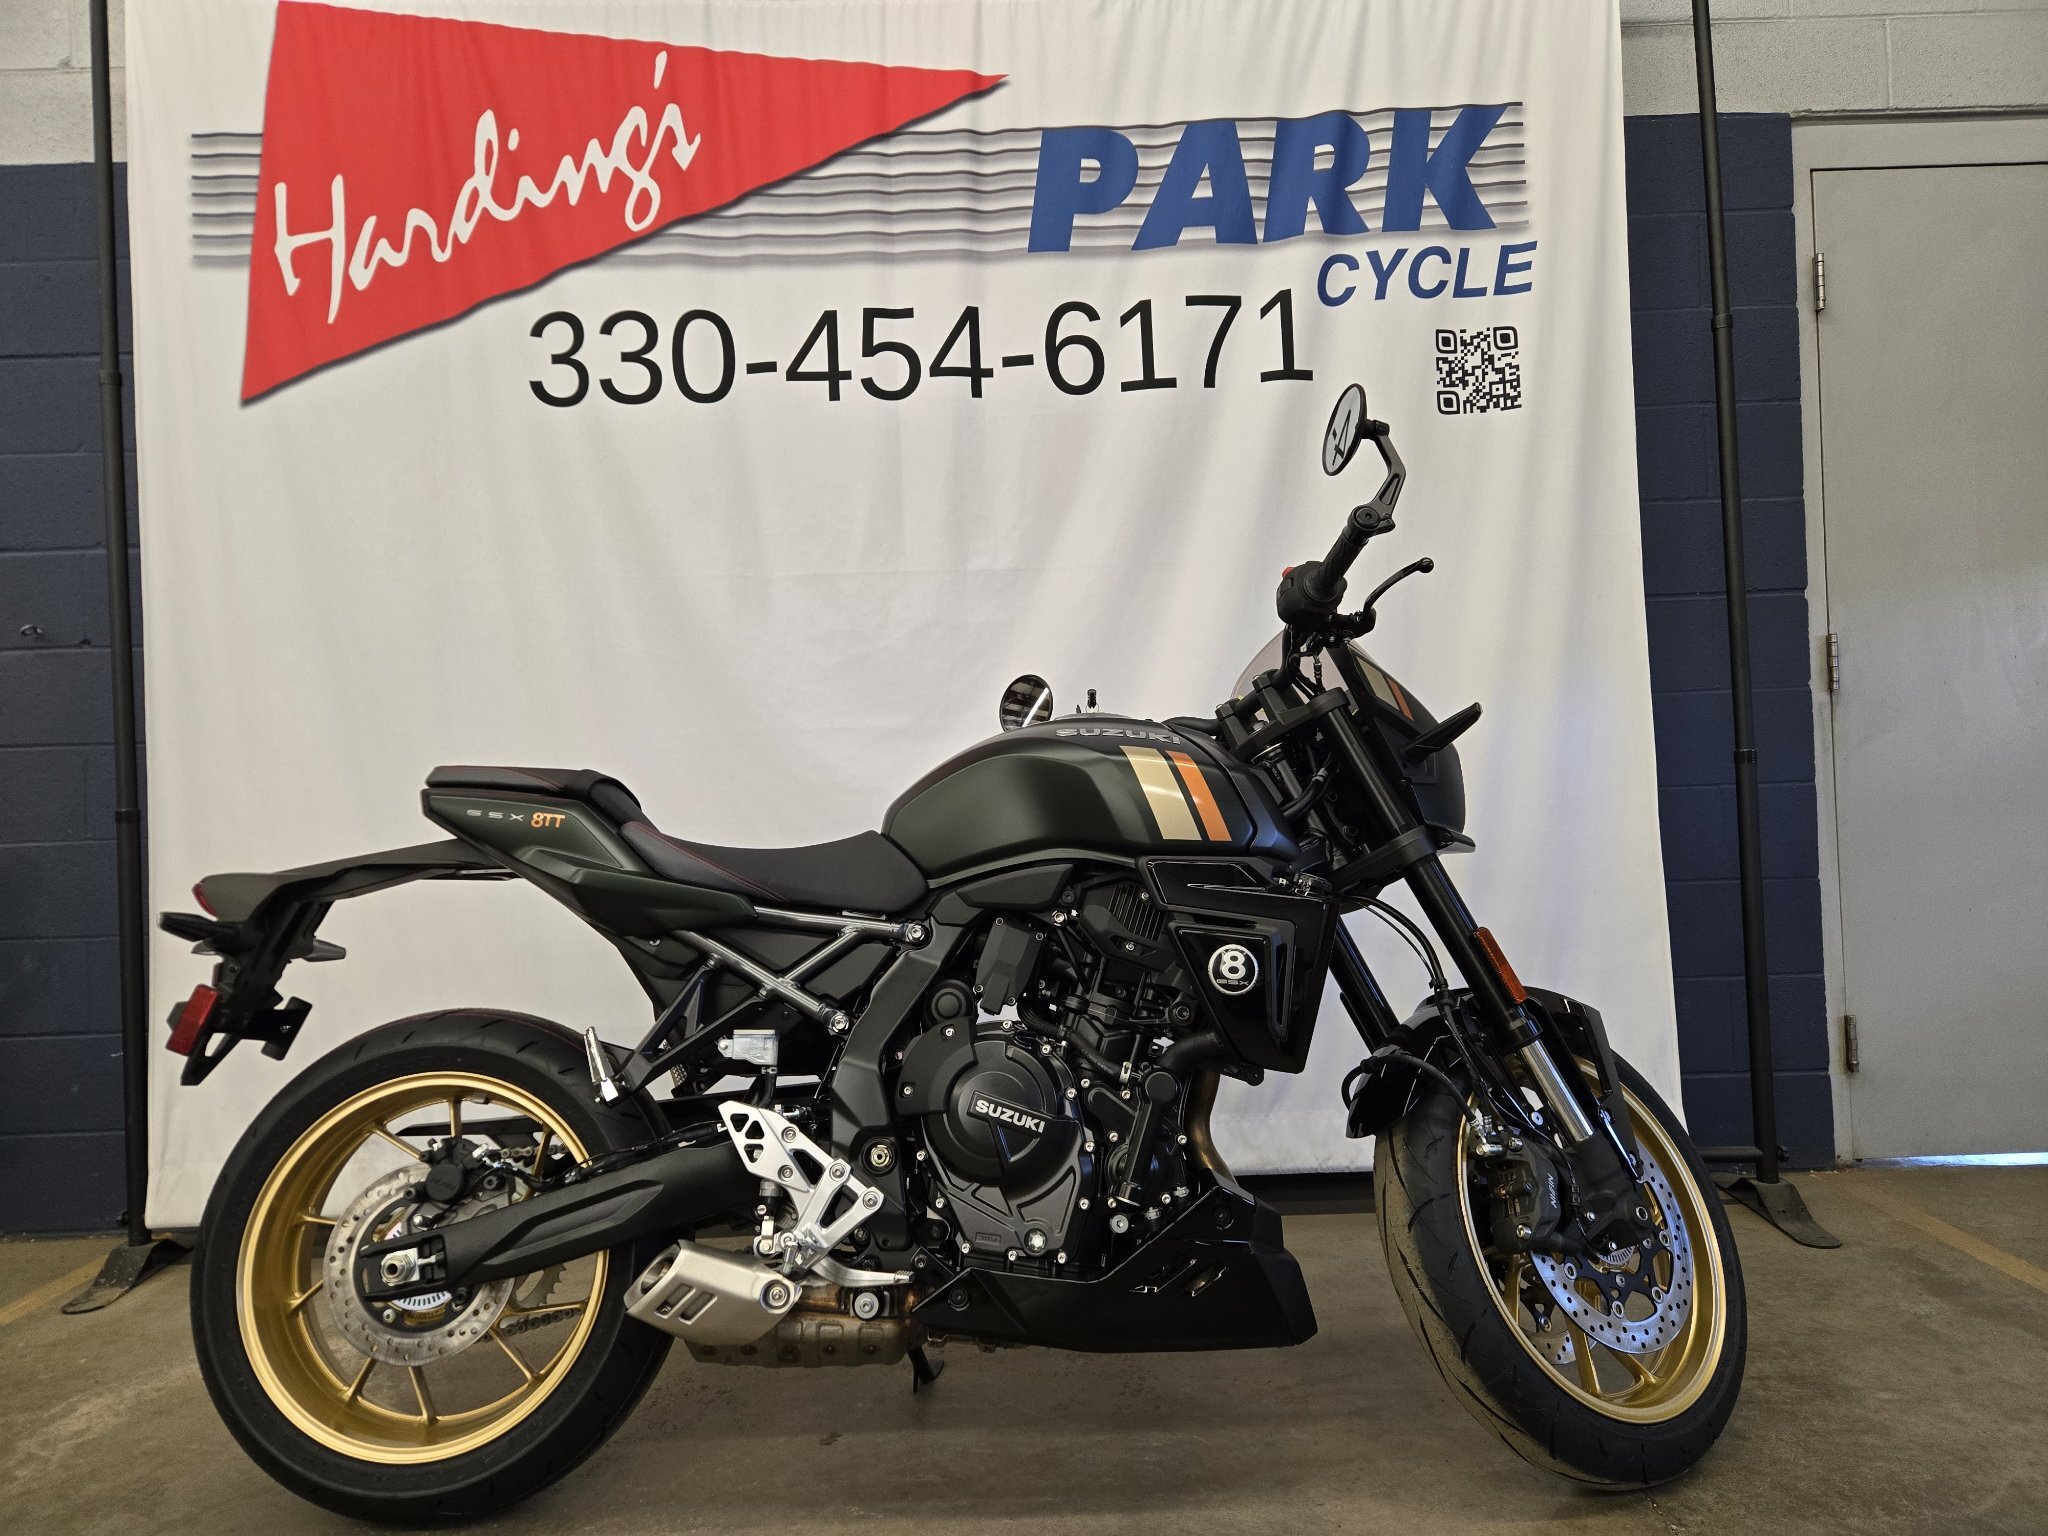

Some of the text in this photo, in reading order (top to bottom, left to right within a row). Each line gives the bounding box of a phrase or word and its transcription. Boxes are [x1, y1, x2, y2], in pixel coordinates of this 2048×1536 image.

[274, 51, 701, 324] Harding's
[1027, 104, 1508, 253] PARK
[1317, 240, 1538, 307] CYCLE
[528, 288, 1314, 408] 330-454-6171
[1055, 728, 1181, 745] SUZUKI
[531, 812, 566, 828] 8TT
[1221, 951, 1246, 979] 8
[975, 1100, 1046, 1133] SUZUKI
